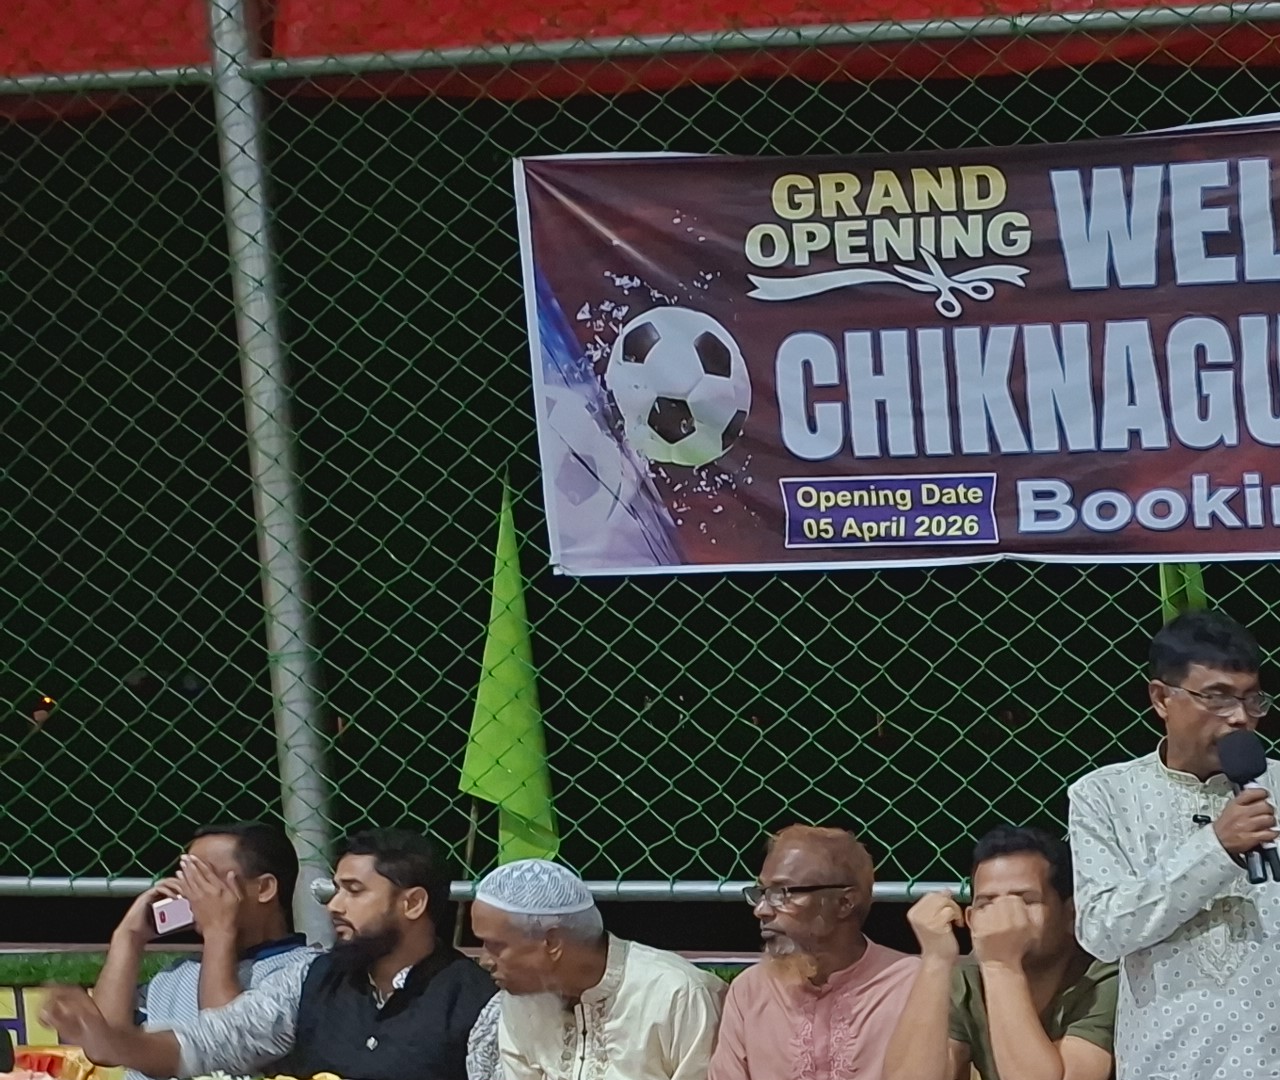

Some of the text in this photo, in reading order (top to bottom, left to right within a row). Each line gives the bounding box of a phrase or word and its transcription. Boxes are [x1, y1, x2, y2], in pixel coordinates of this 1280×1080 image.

[771, 165, 1007, 219] GRAND
[744, 211, 1032, 267] OPENING
[796, 483, 983, 511] Opening Date
[803, 515, 979, 542] 05 April 2026
